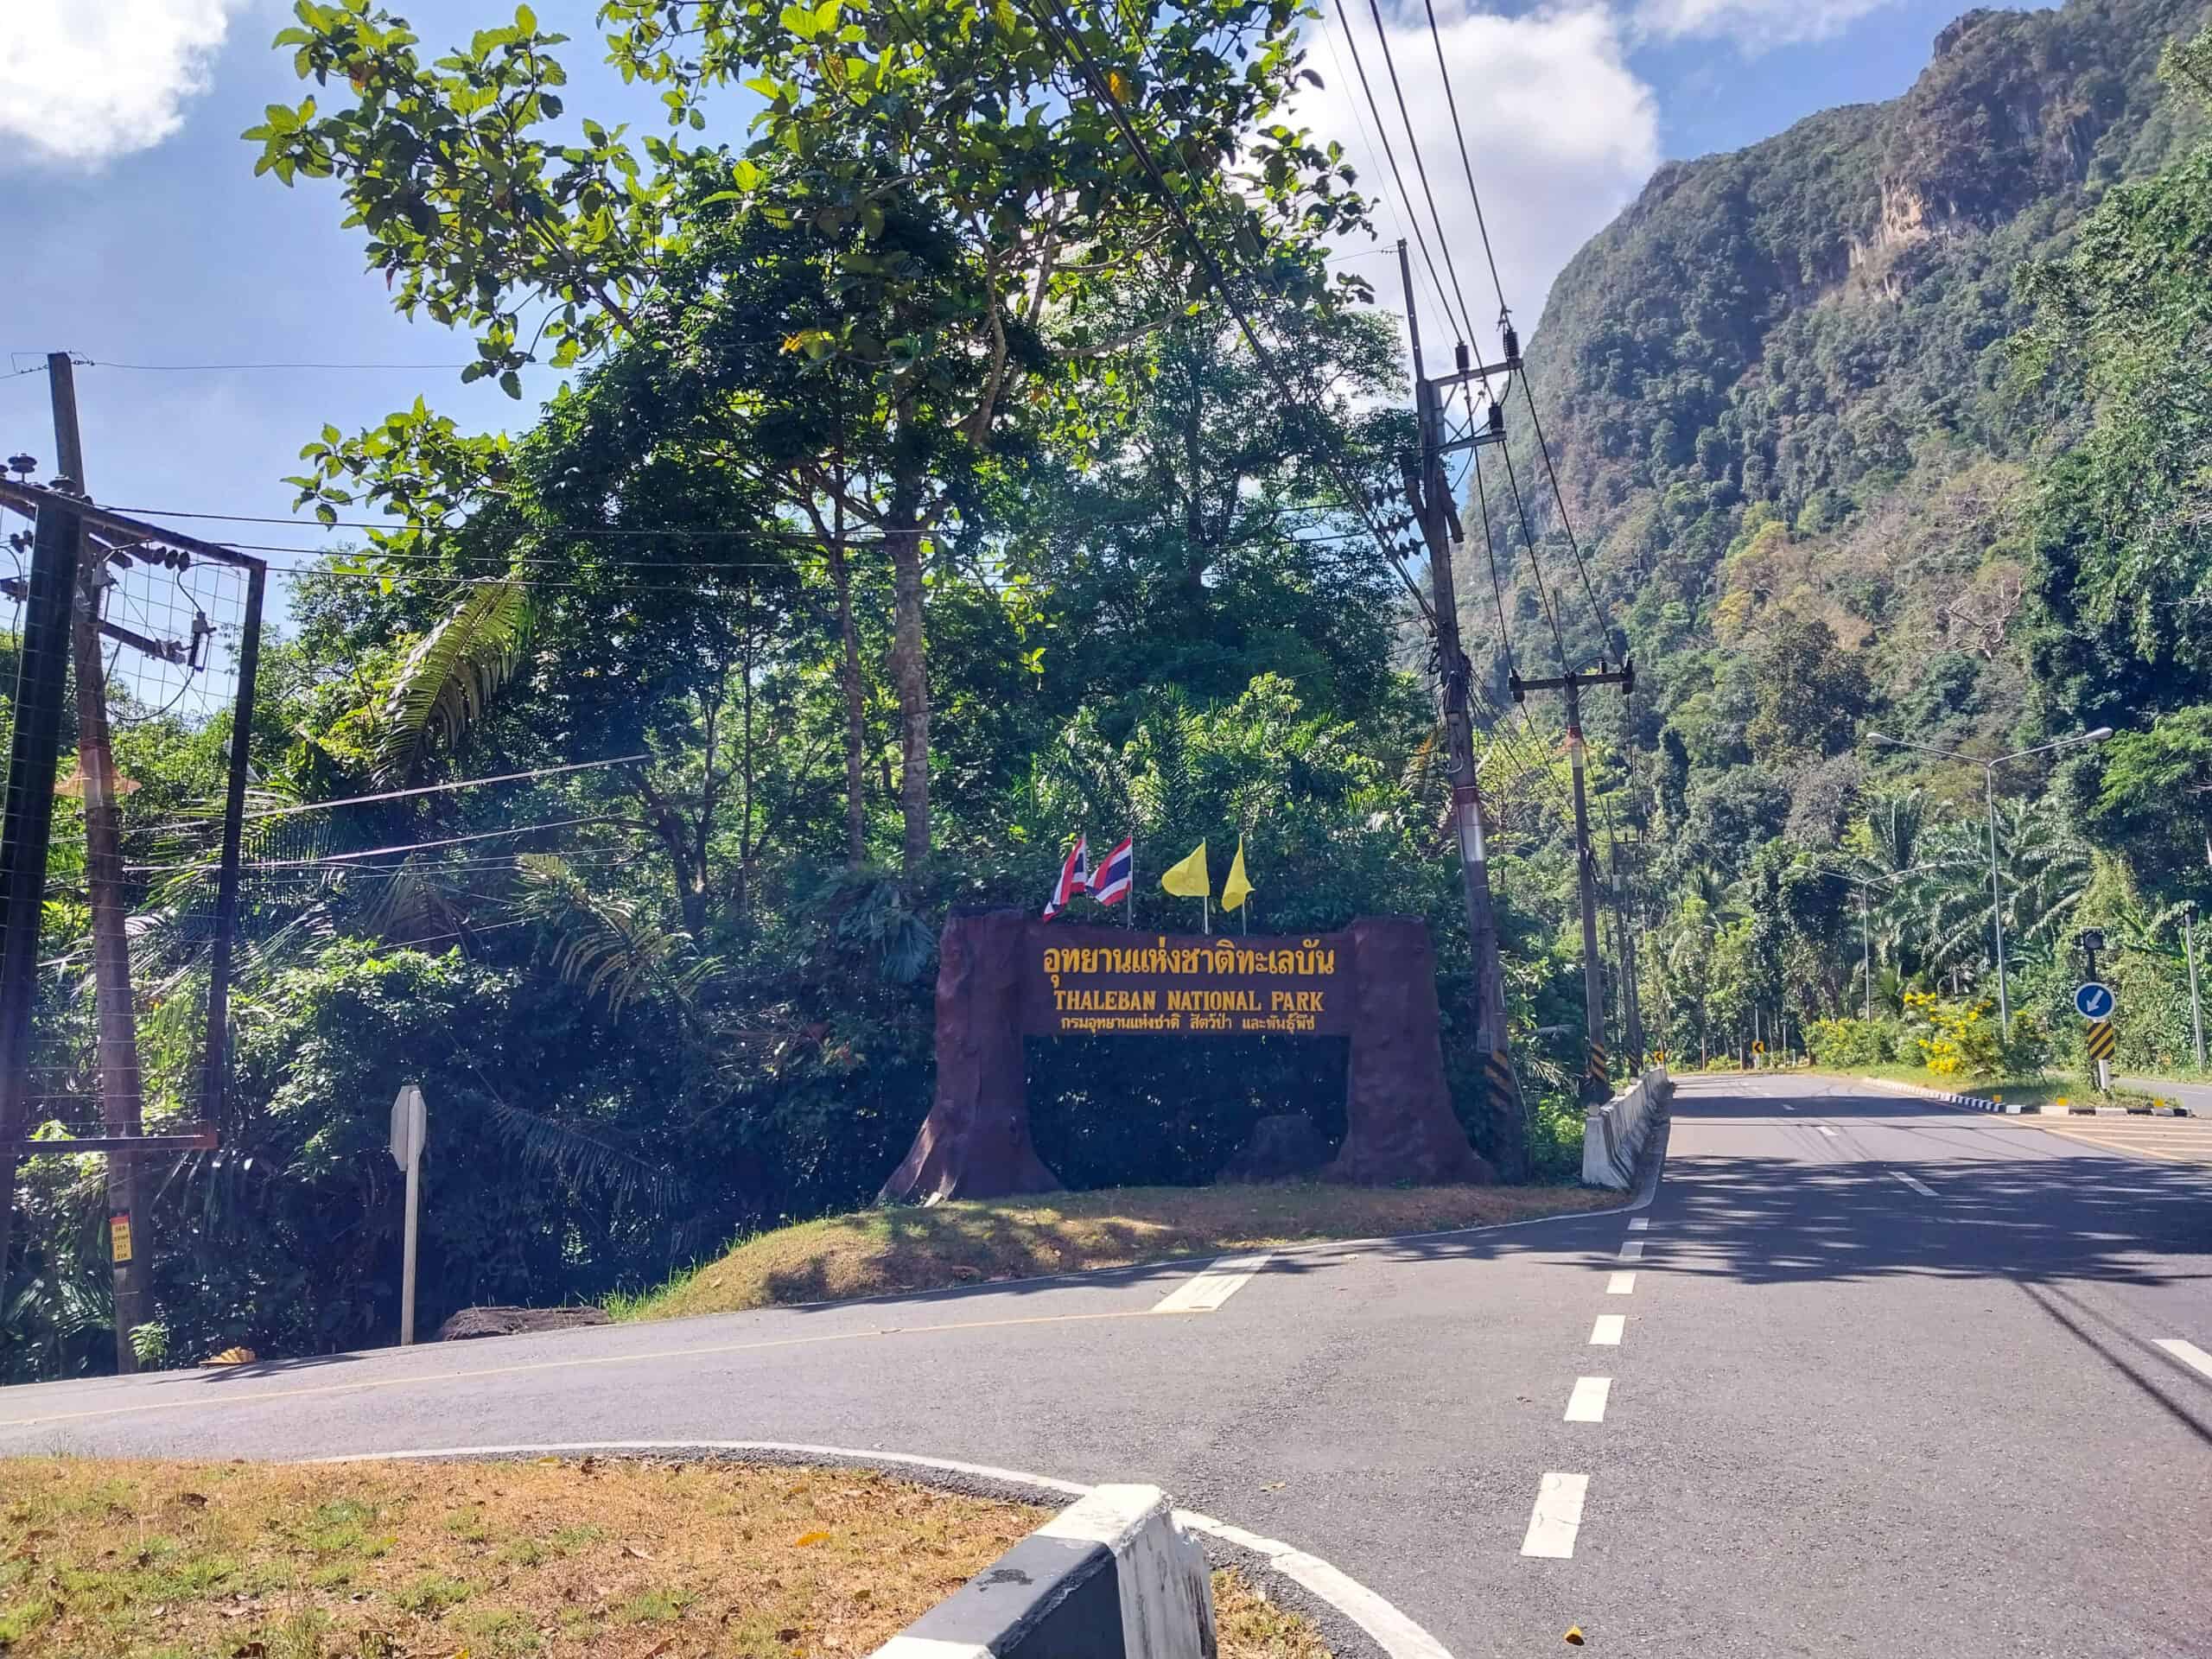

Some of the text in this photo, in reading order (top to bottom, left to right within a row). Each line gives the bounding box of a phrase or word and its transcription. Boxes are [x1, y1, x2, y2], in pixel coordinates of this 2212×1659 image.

[1044, 936, 1334, 988] อุทยานแห่งชาติทะเลบัน
[1054, 990, 1325, 1011] THALEBAN NATIONAL PARK
[1061, 1013, 1181, 1033] กรมอุทยานแห่งชาติ
